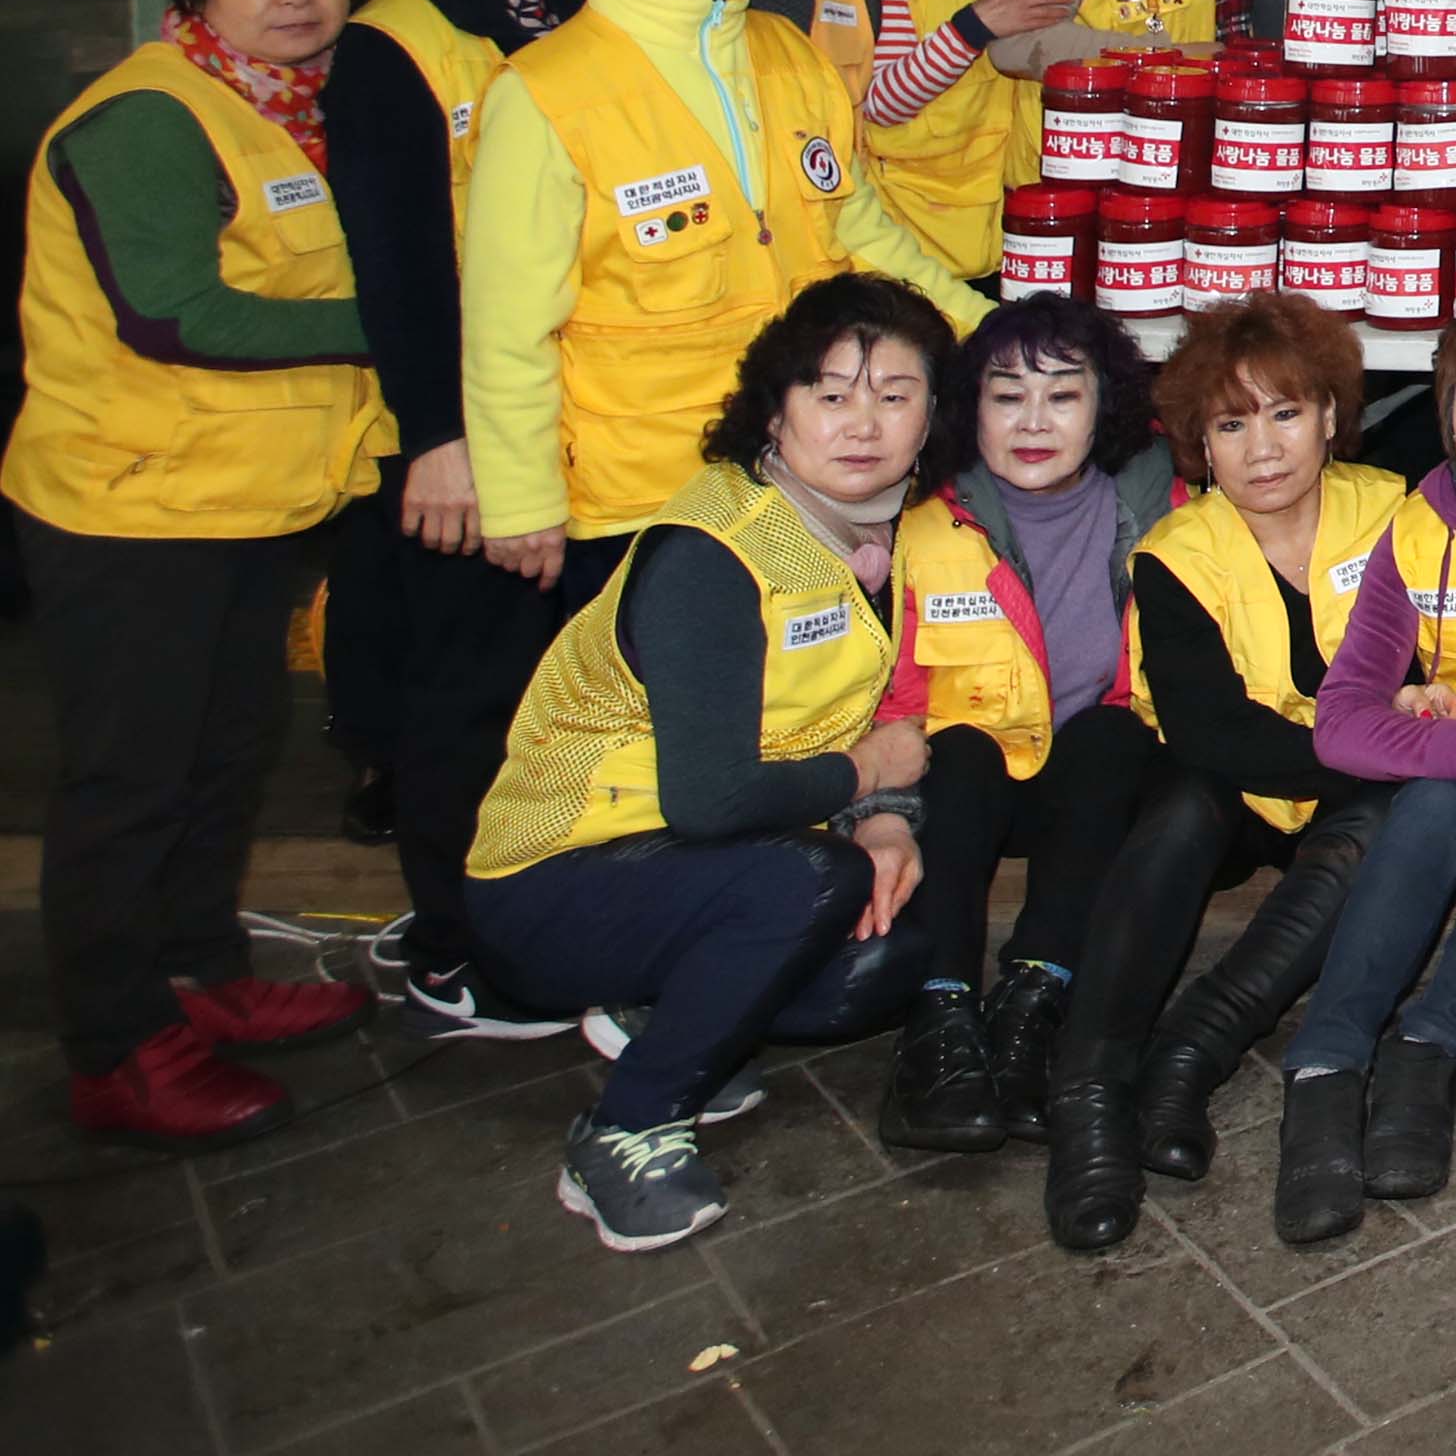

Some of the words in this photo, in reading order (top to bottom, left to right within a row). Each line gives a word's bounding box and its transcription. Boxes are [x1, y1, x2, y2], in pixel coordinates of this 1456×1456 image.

[1291, 15, 1346, 40] 사랑나눔
[1389, 10, 1442, 31] 사랑나눔
[1046, 136, 1105, 154] 사랑나눔
[1218, 146, 1269, 164] 사랑나눔
[1189, 269, 1244, 287] 사랑나눔
[1285, 266, 1335, 284] 사랑나눔
